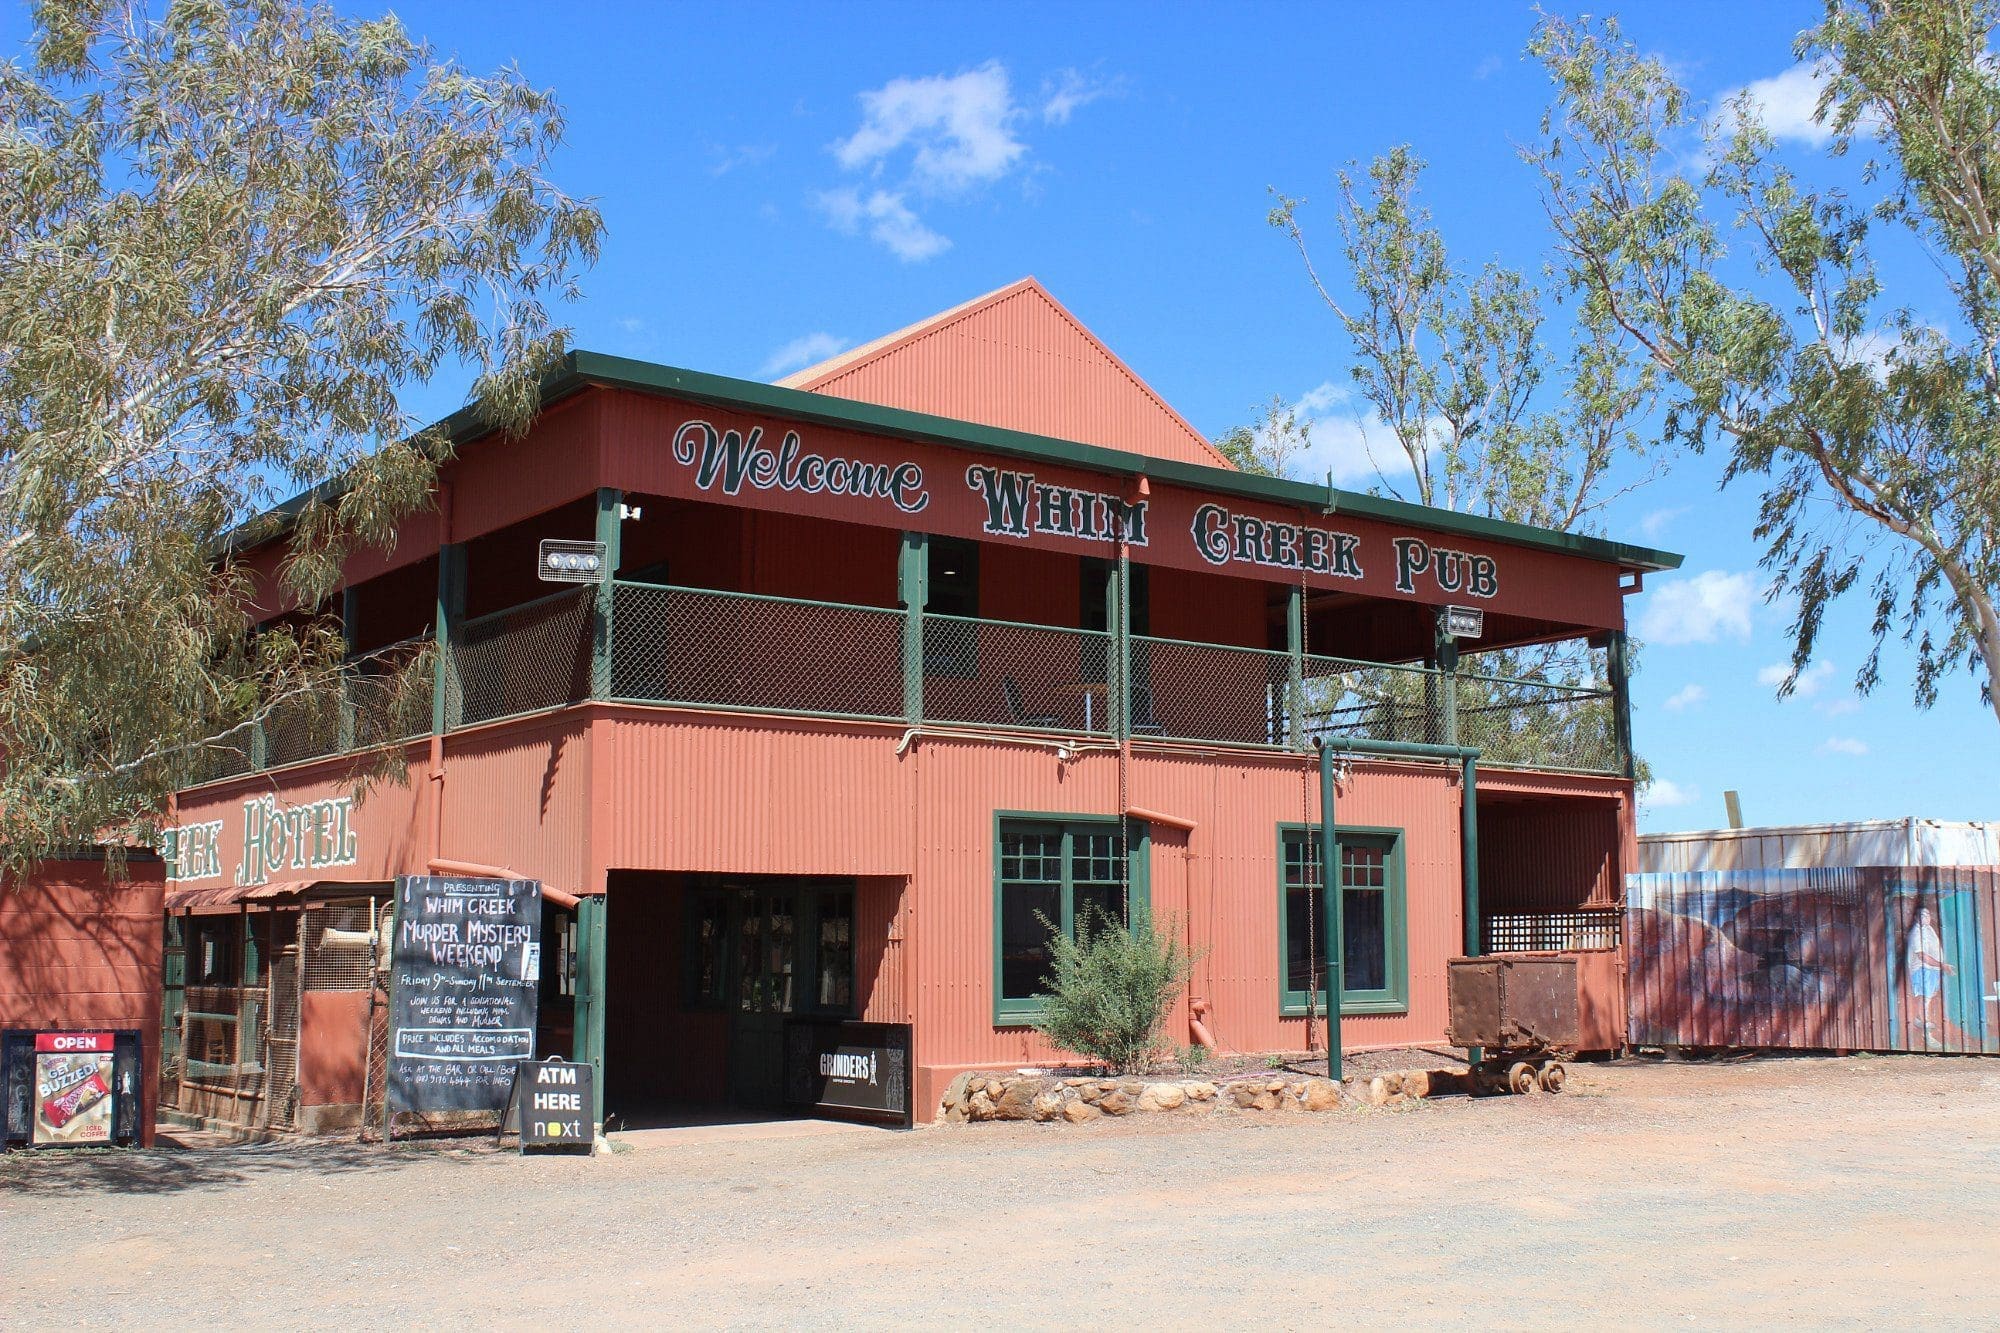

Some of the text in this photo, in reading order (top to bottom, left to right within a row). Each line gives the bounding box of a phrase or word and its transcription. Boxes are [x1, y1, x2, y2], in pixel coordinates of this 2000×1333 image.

[672, 419, 1498, 599] Welcome WHIM CREEK PUB
[234, 793, 357, 886] HOTEL
[443, 882, 500, 894] PRESENTING
[426, 897, 516, 915] WHIM CREEK
[402, 920, 531, 947] MURDER MYSTERY
[432, 943, 502, 967] WEEKEND
[401, 974, 430, 986] FRIDAY
[54, 1037, 97, 1049] OPEN
[402, 1033, 424, 1044] PRICE
[429, 1033, 465, 1043] INCLUDES
[435, 1044, 496, 1054] AND ALL MEALS
[49, 1063, 71, 1079] GET
[820, 1053, 869, 1079] GRINDERS
[39, 1062, 99, 1098] BUZZED!
[537, 1067, 577, 1084] ATM
[534, 1092, 581, 1110] HERE
[534, 1119, 581, 1138] nxt
